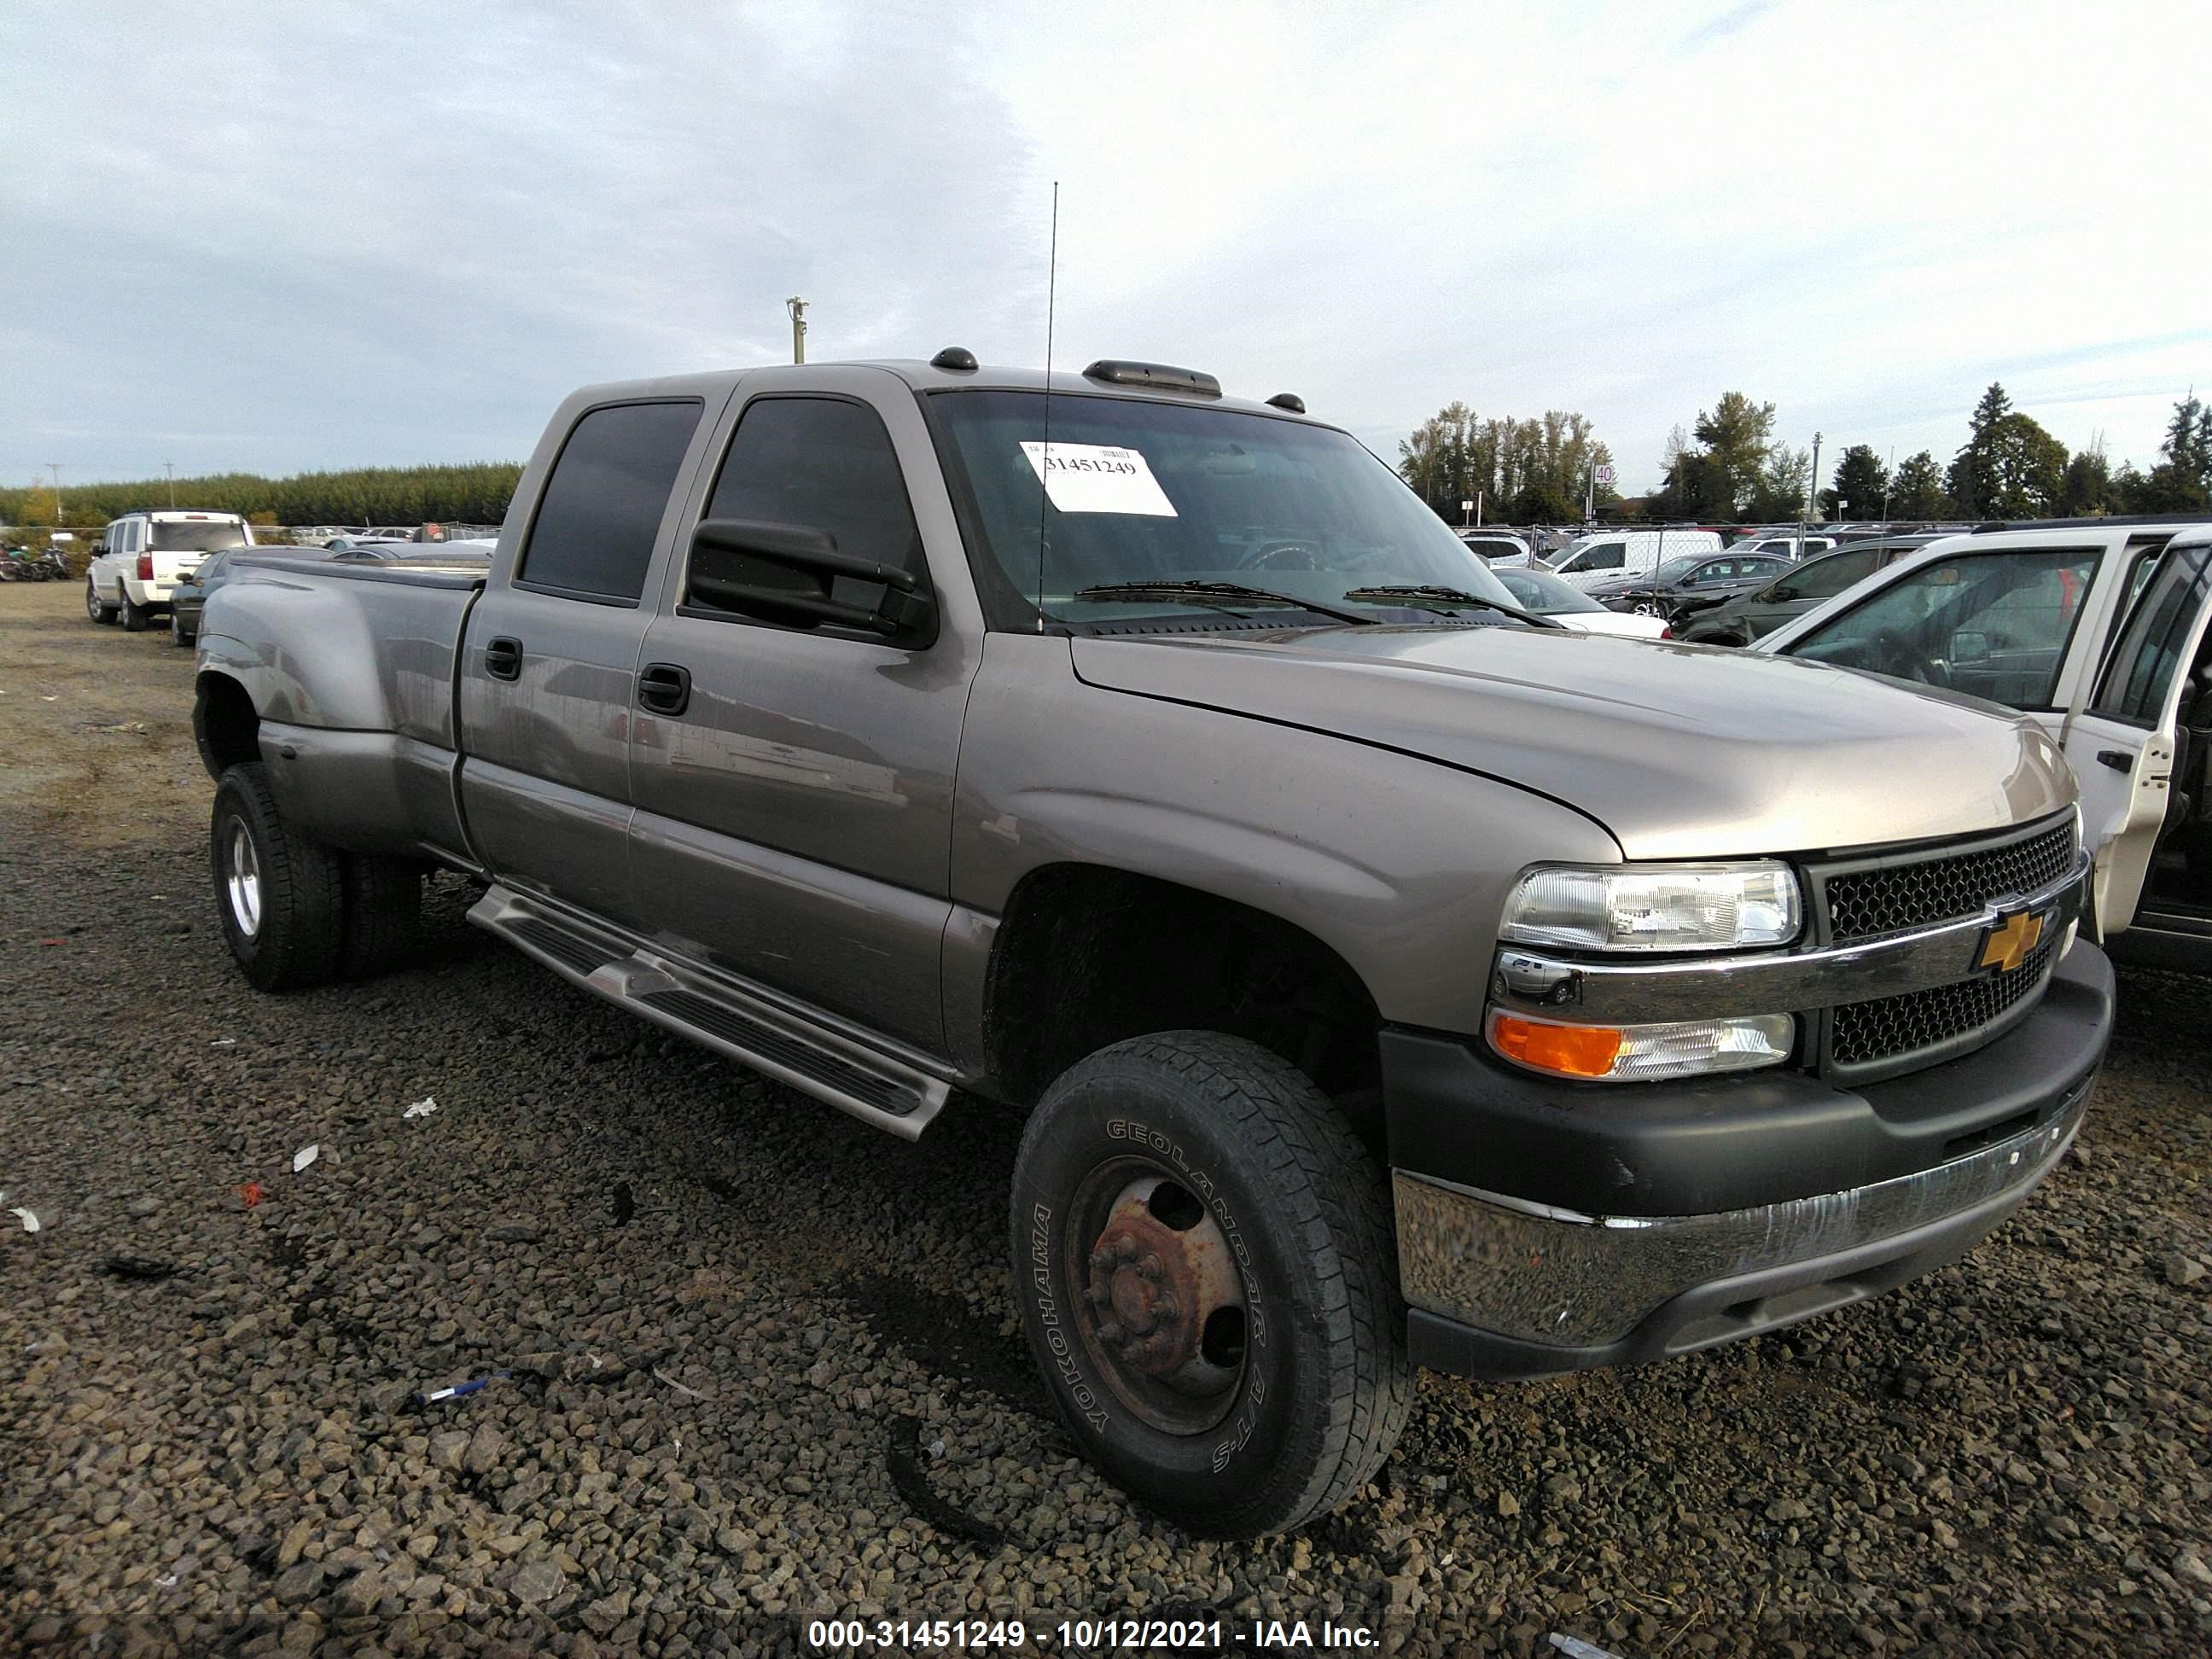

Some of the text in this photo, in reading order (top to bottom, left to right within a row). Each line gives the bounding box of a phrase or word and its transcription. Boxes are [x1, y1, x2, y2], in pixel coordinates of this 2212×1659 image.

[1044, 457, 1136, 475] 31451249
[1597, 467, 1612, 481] 40
[1106, 1119, 1268, 1348] GEOLANDAR
[1031, 1202, 1112, 1435] YOKOHAMA
